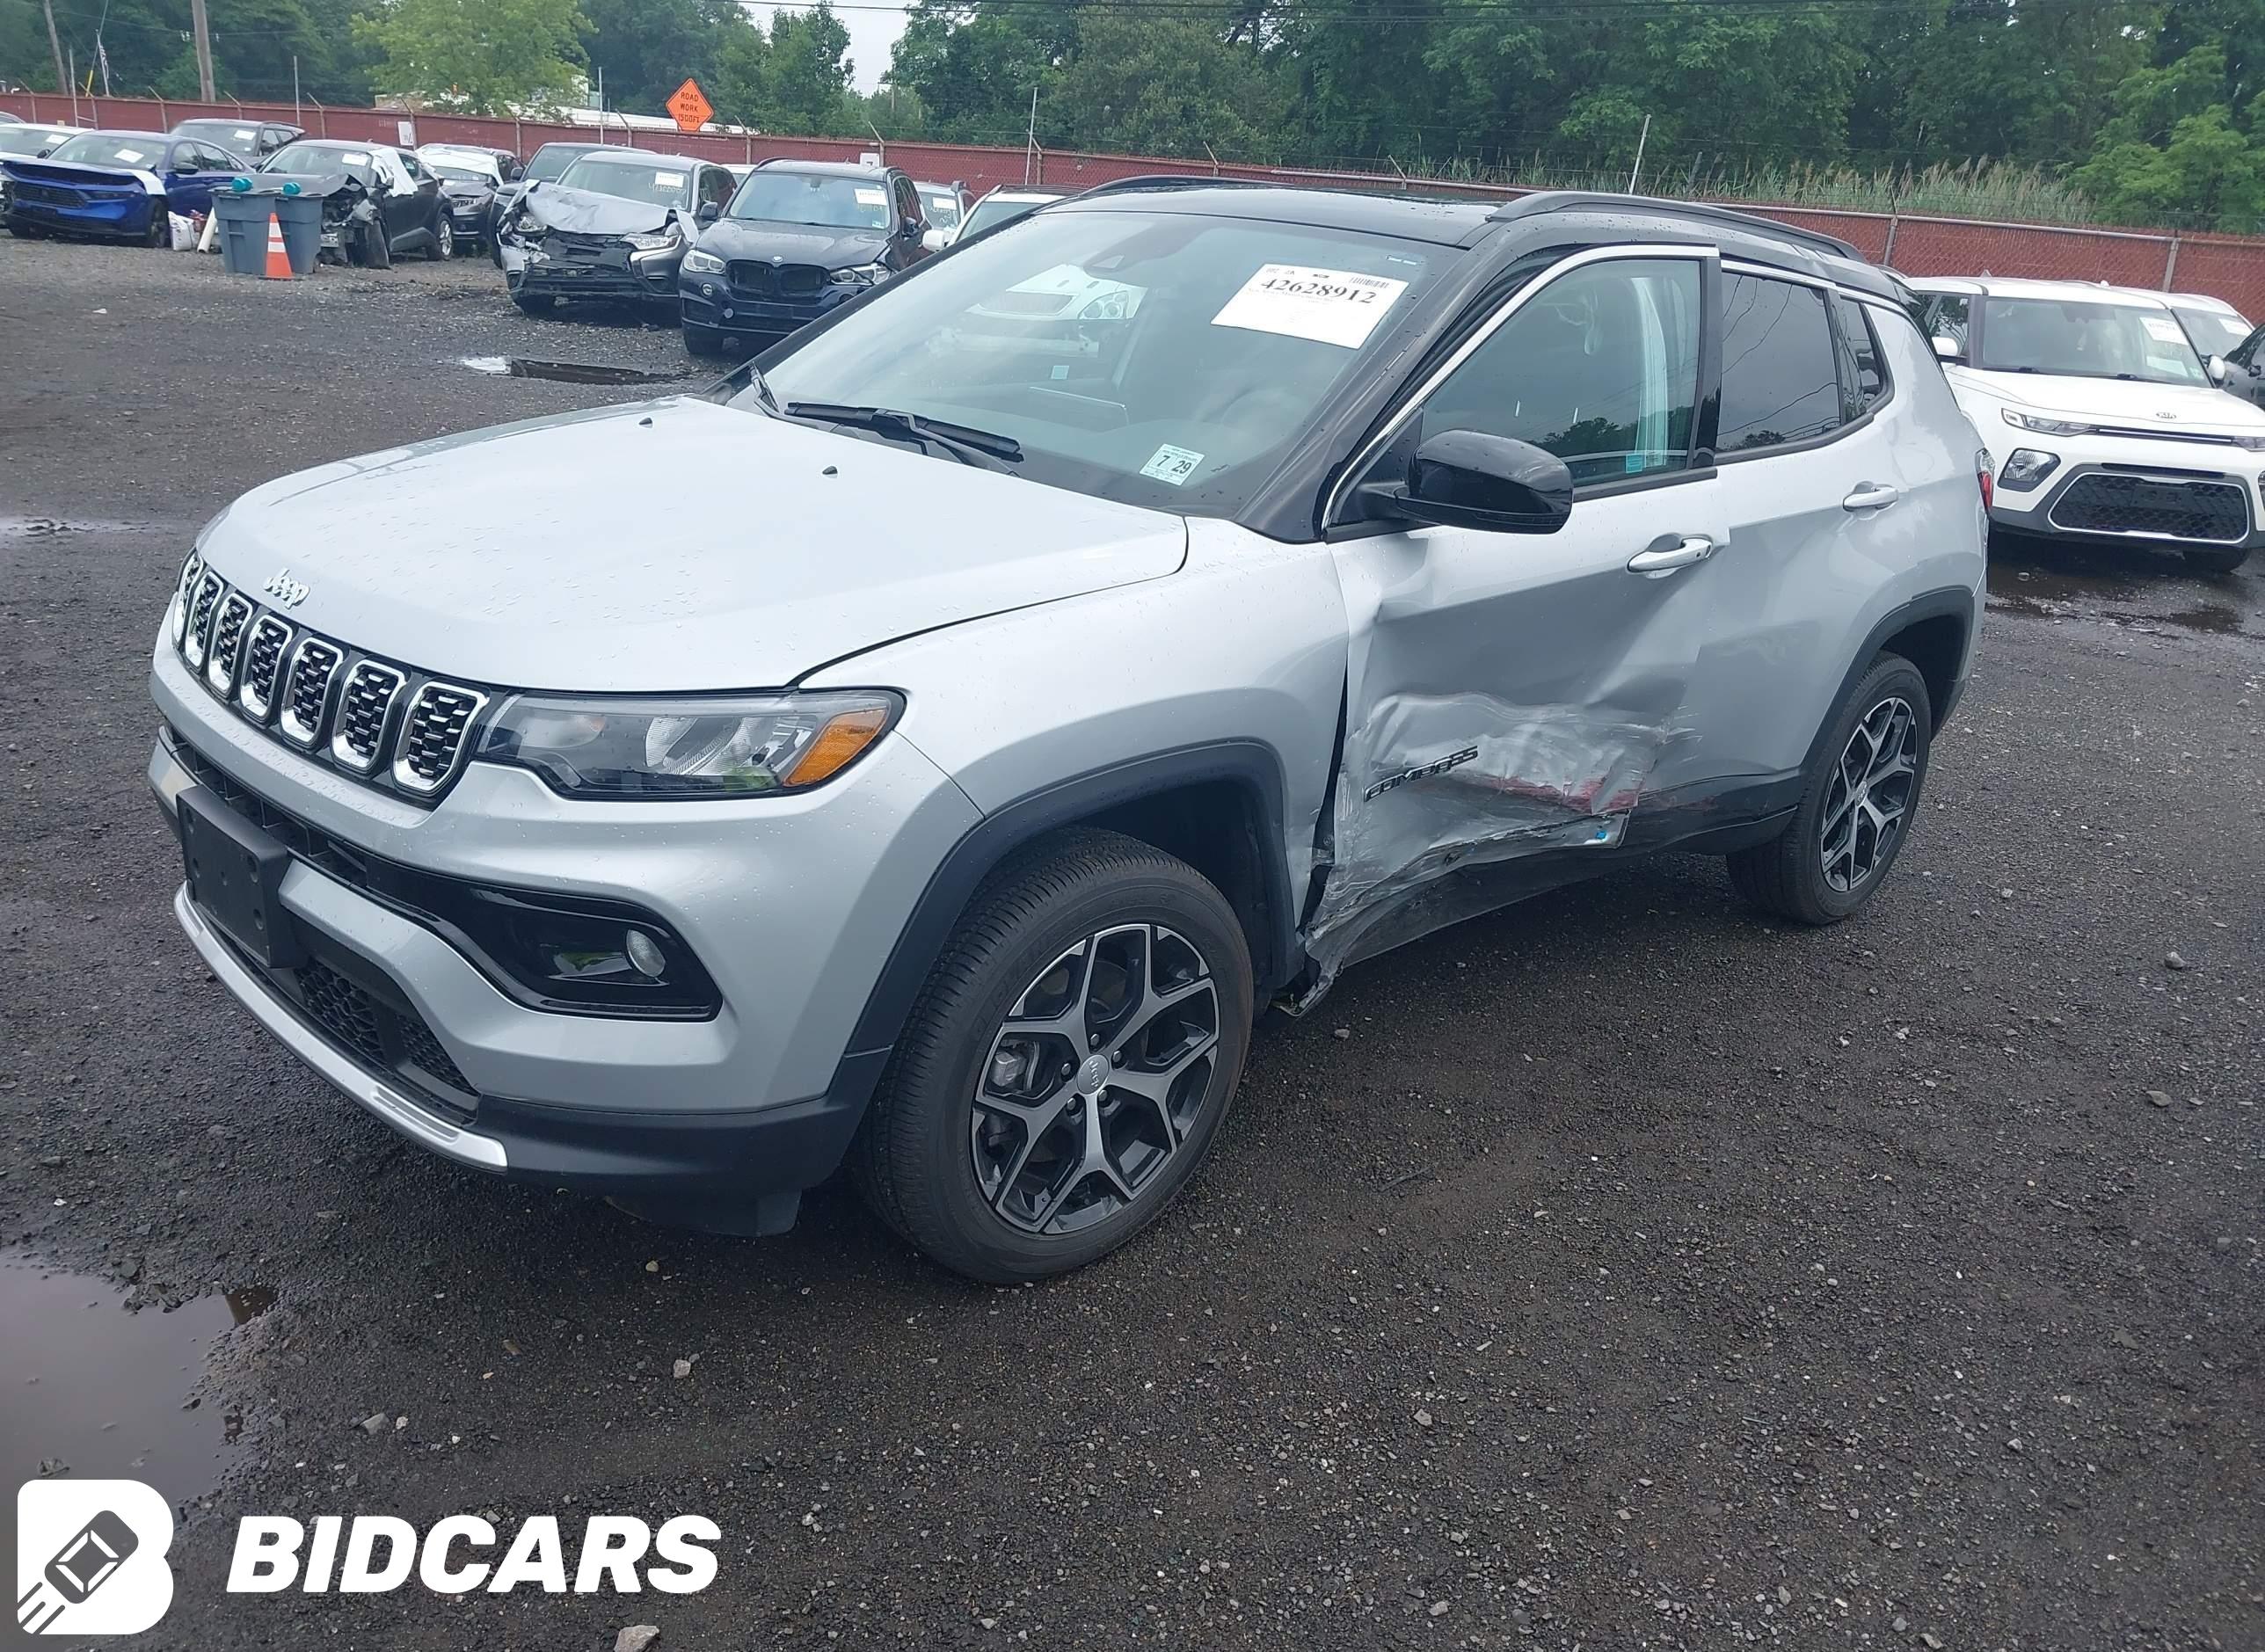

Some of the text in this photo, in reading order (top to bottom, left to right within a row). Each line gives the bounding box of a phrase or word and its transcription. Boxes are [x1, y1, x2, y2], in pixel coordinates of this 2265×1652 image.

[681, 91, 699, 102] ROAD
[680, 102, 698, 113] WORK
[1261, 279, 1377, 303] 42628912
[1157, 455, 1170, 467] 7
[1172, 460, 1192, 474] 29
[263, 568, 310, 610] Jeep
[1364, 745, 1479, 803] COMPASS
